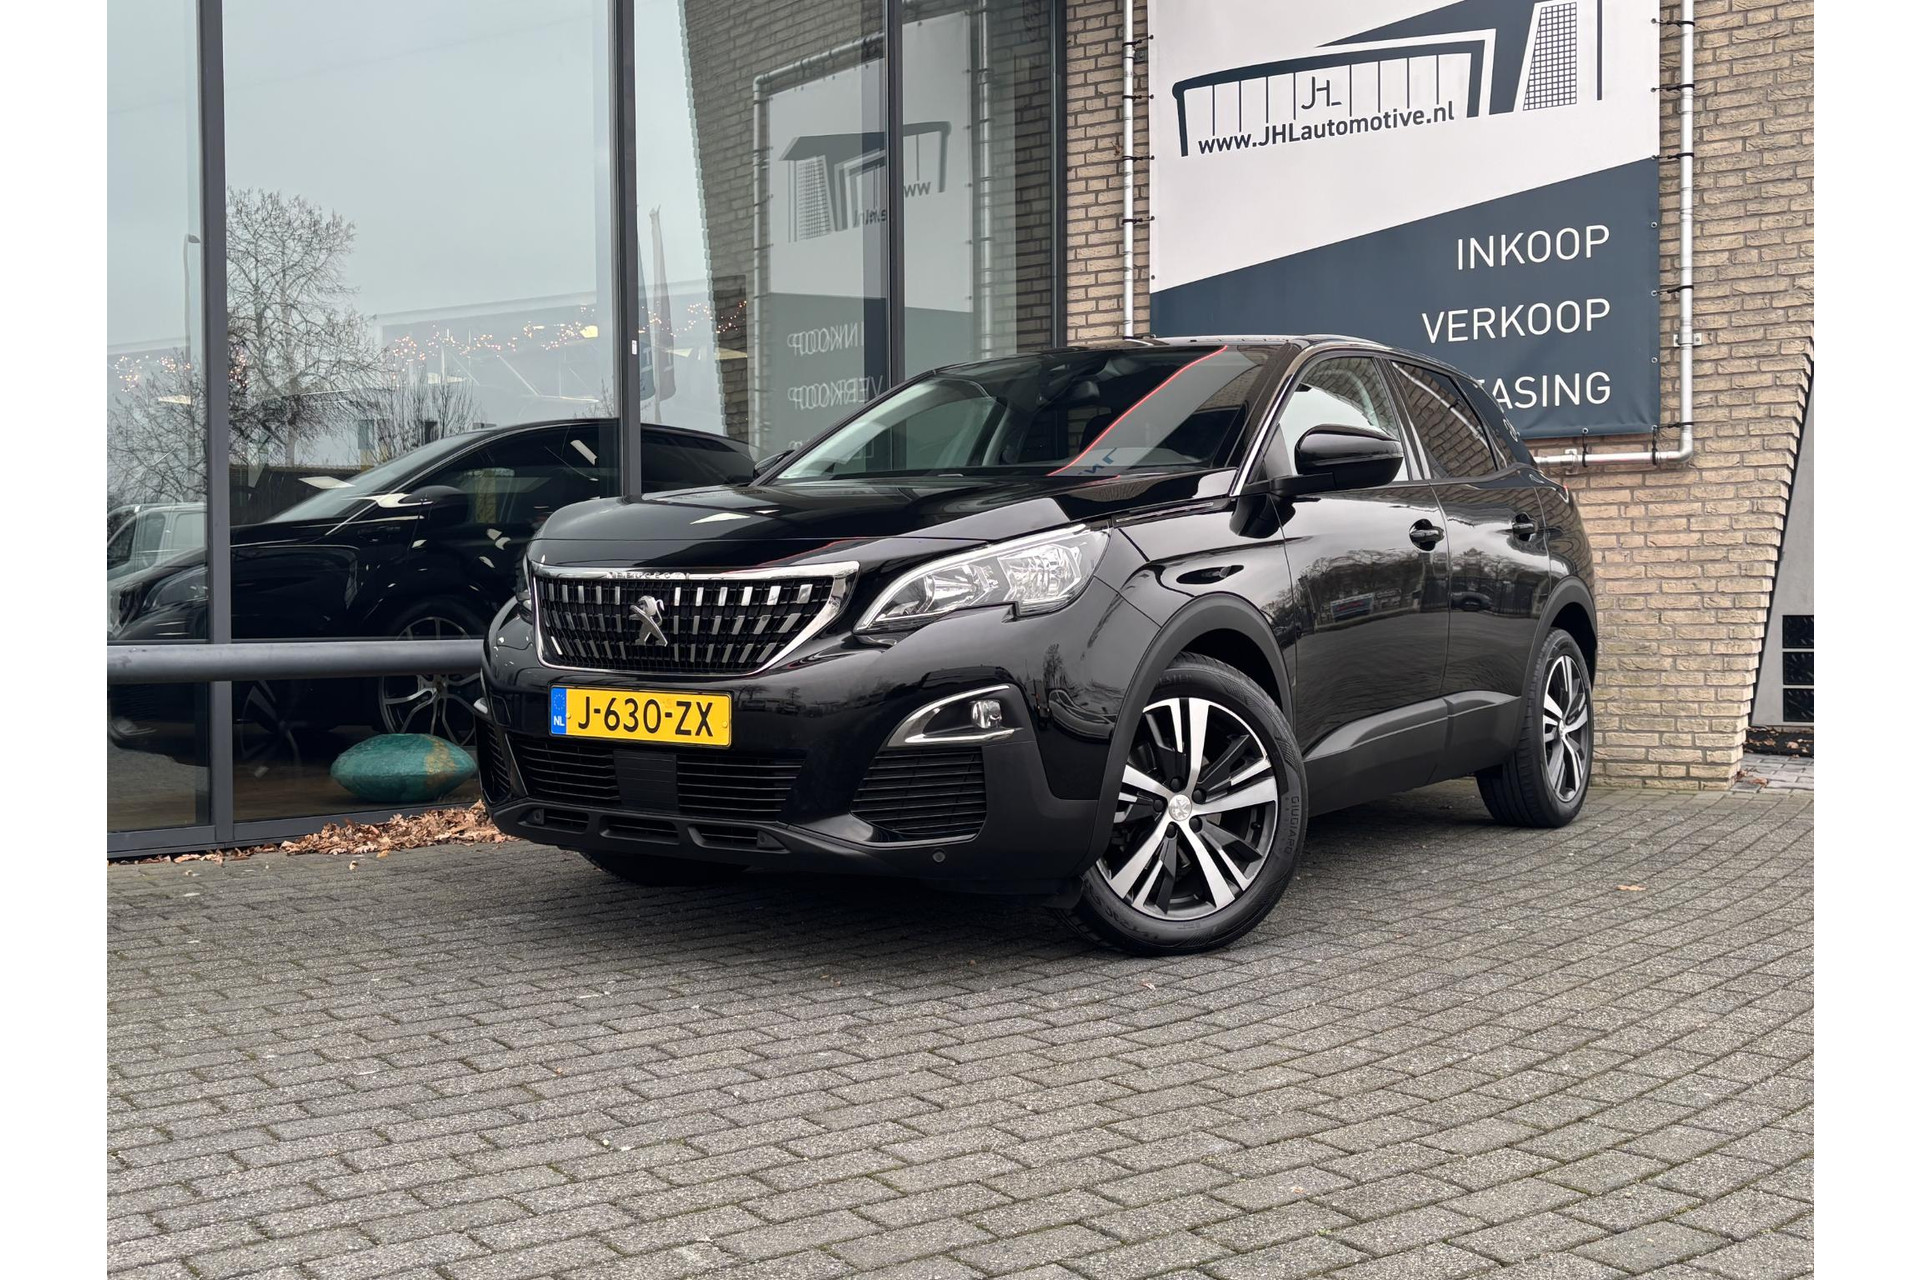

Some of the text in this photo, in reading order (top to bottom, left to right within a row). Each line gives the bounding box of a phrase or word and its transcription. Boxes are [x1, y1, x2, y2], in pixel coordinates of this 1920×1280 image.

[1301, 76, 1342, 110] JHL
[1198, 100, 1455, 154] www.JHLautomotive.nl
[1457, 224, 1610, 271] INKOOP
[1421, 298, 1611, 344] VERKOOP
[1474, 371, 1611, 410] ASING
[553, 715, 565, 727] NL
[578, 696, 714, 737] J-630-ZX
